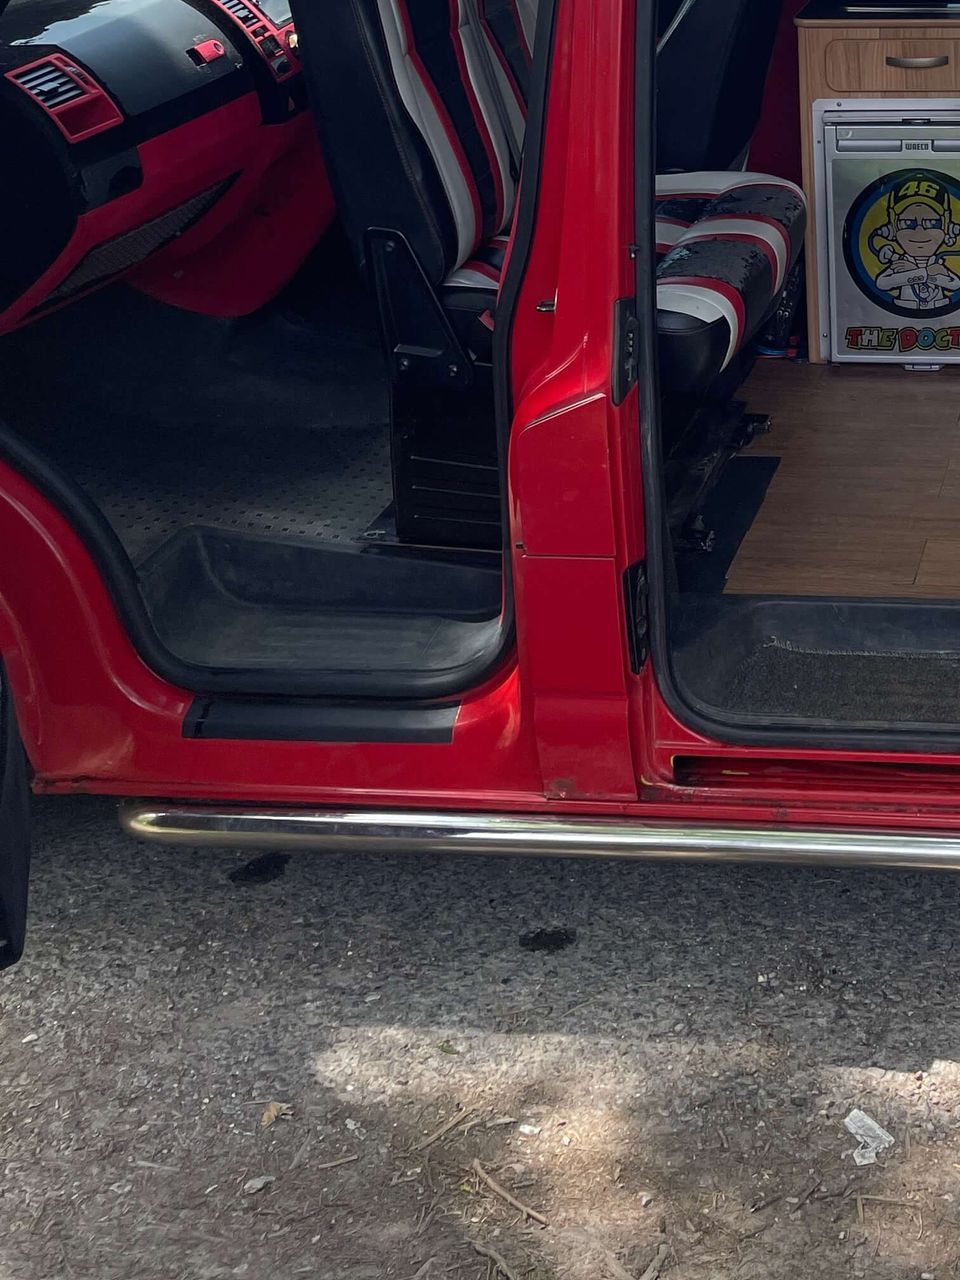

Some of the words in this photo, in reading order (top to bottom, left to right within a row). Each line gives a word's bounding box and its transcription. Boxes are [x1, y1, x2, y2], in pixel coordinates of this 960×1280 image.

[905, 143, 929, 151] WAECO
[898, 180, 940, 198] 46
[846, 327, 897, 350] THE
